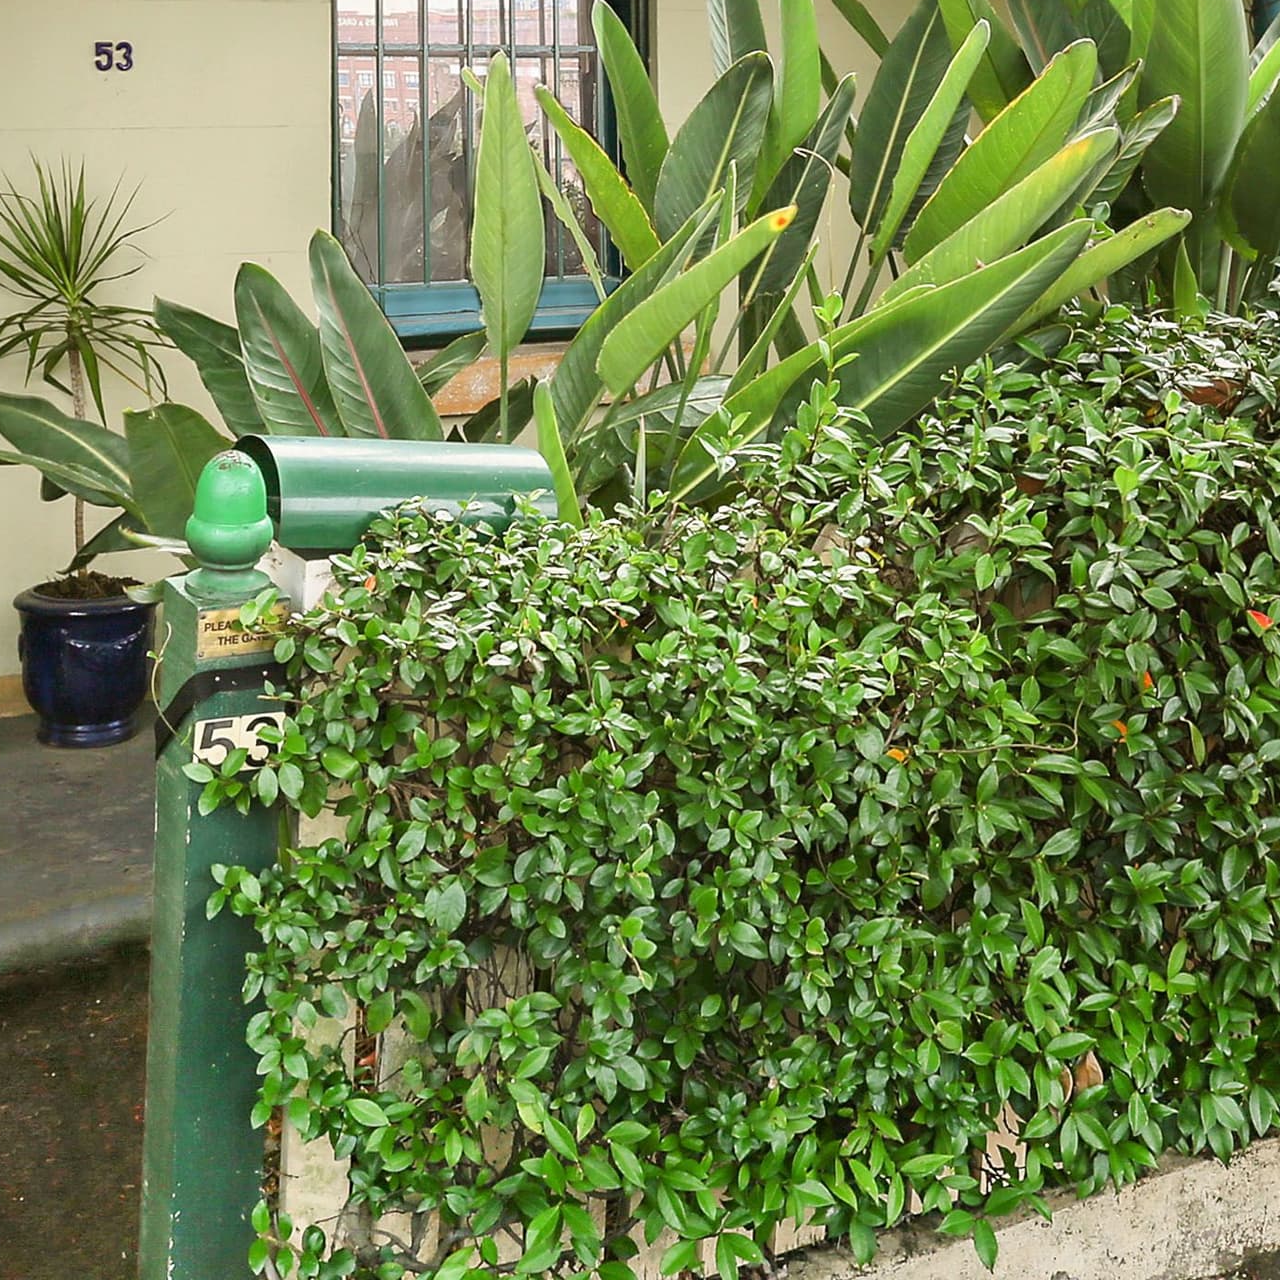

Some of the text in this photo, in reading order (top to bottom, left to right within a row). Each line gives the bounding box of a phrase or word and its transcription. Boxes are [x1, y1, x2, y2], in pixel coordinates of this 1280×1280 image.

[95, 42, 133, 71] 53
[217, 634, 238, 646] THE
[200, 716, 279, 772] 53
